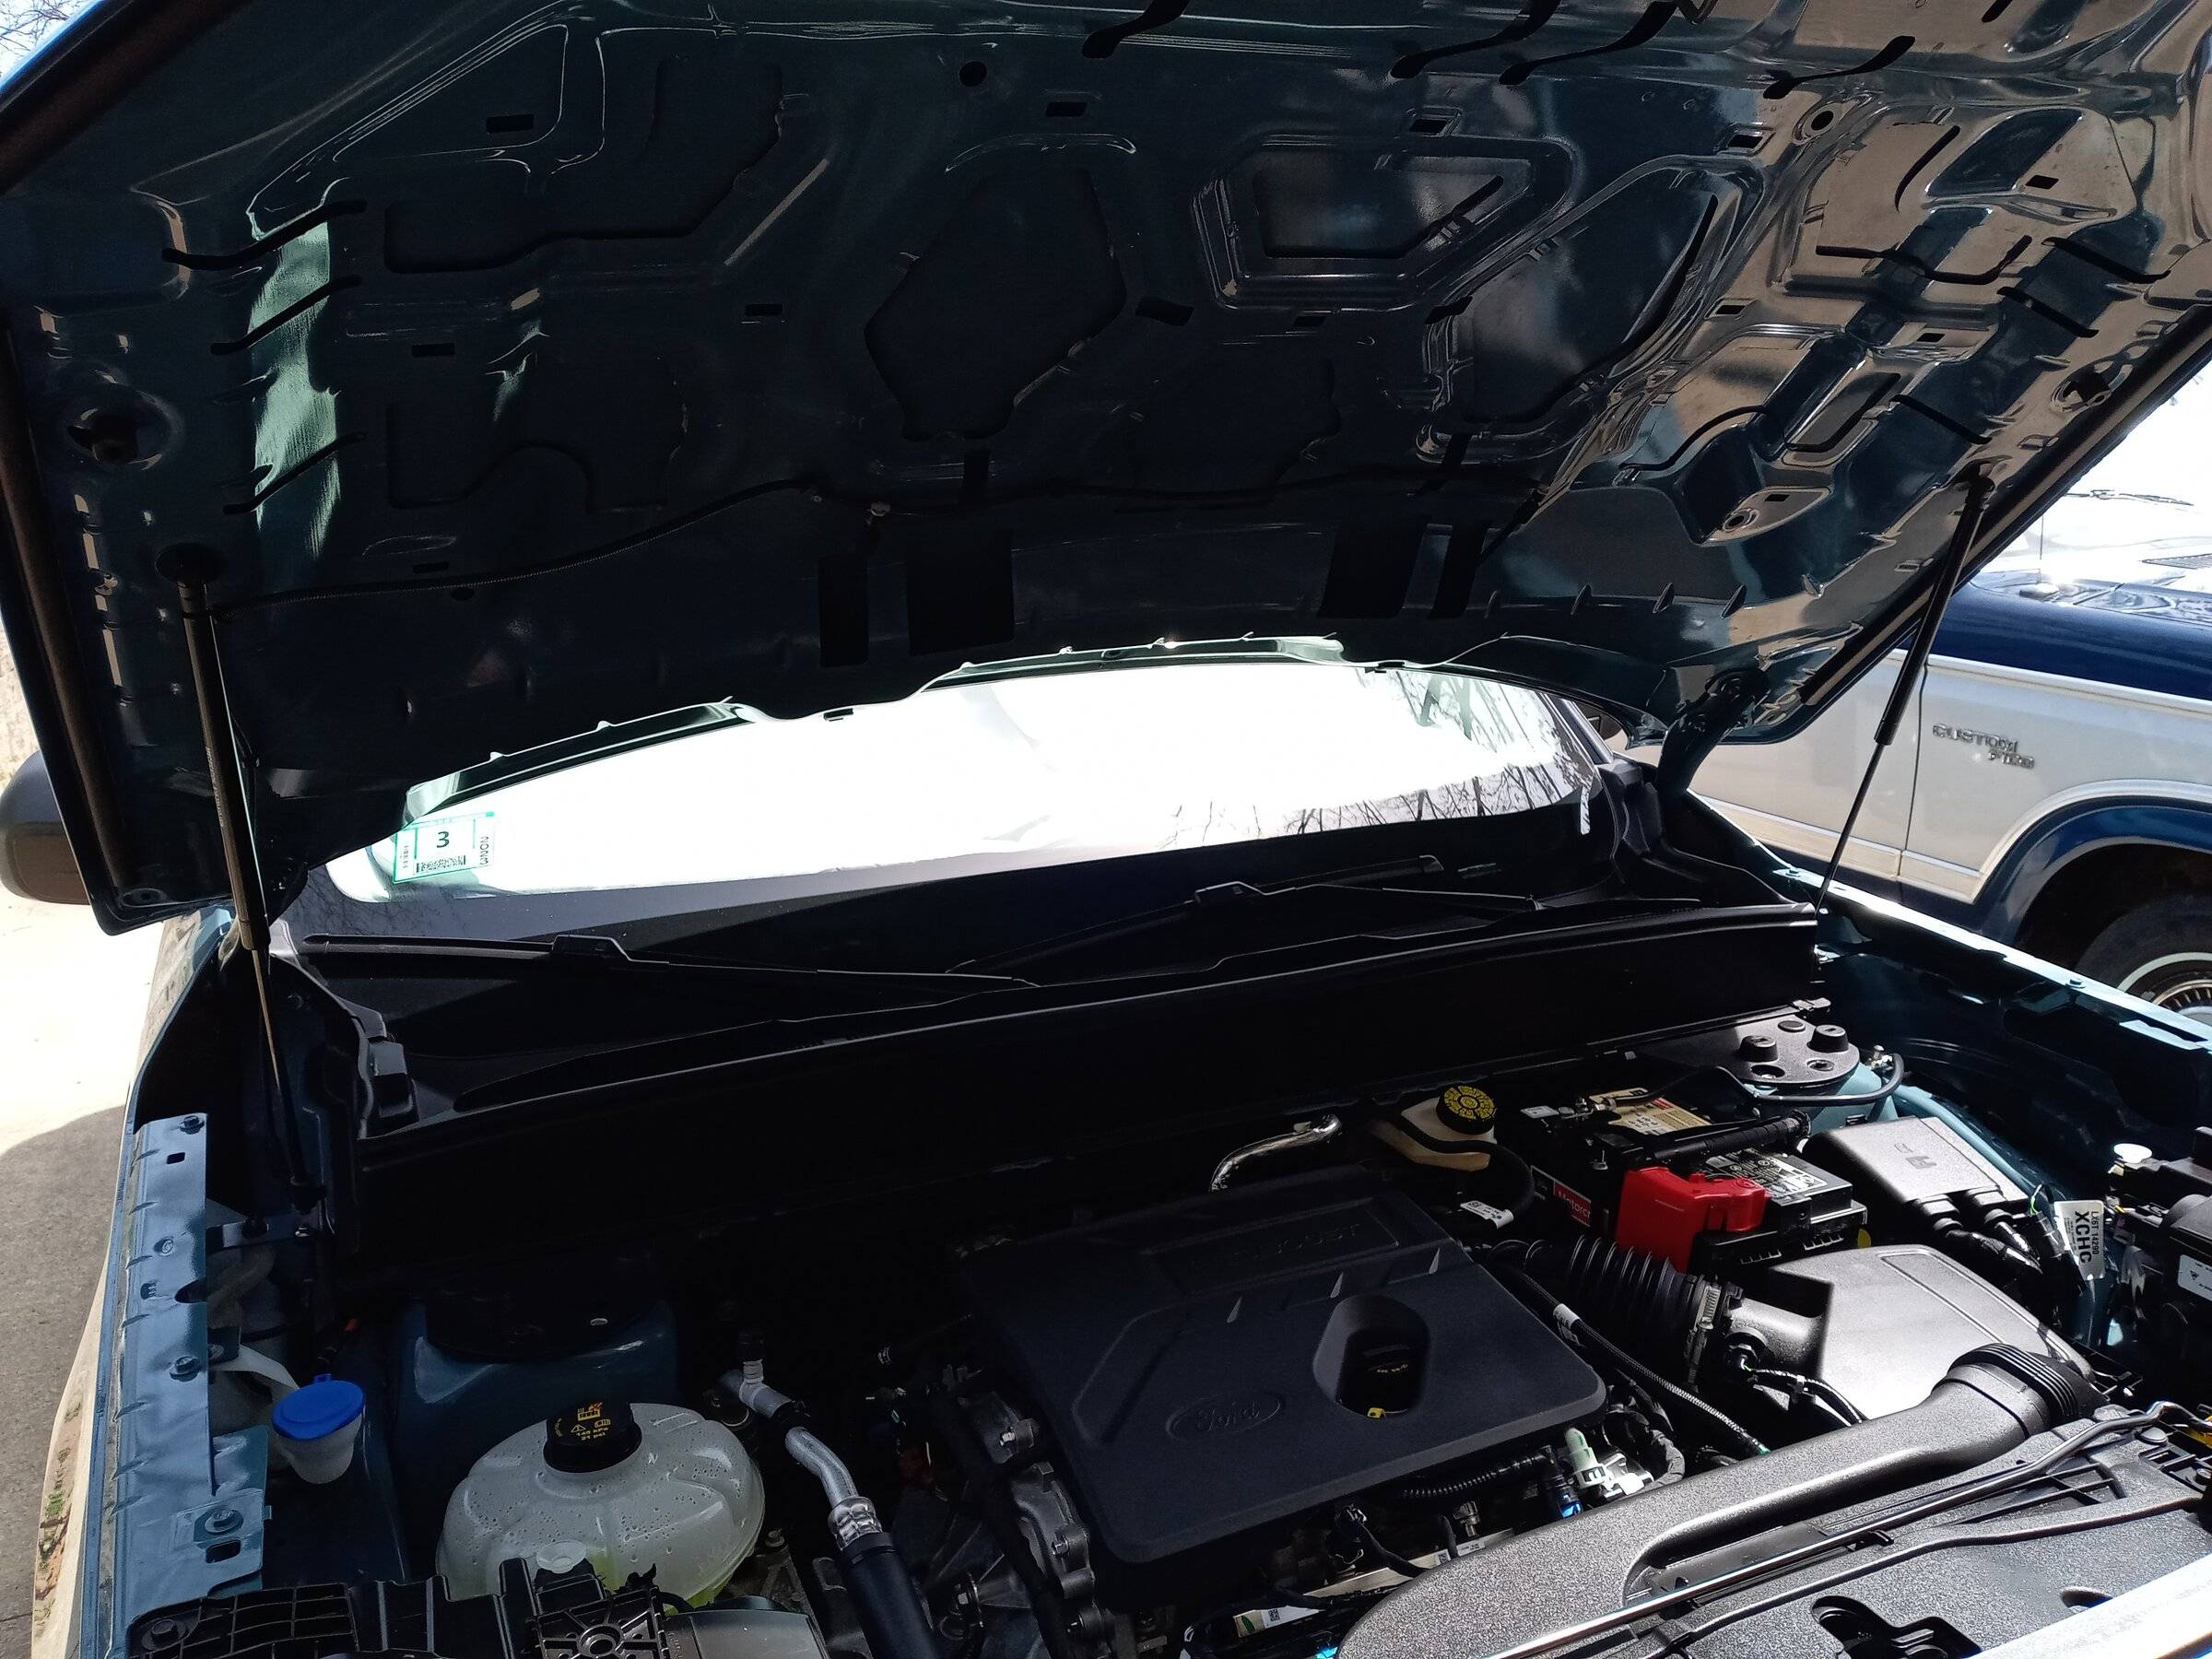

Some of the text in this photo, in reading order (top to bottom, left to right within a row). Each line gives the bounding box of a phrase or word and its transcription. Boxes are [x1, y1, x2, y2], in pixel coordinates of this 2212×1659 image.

[1932, 723, 2019, 753] CUSTOM
[436, 830, 450, 848] 3
[479, 836, 489, 865] 2023
[2075, 1210, 2092, 1264] XCHC
[1194, 1400, 1261, 1433] Ford
